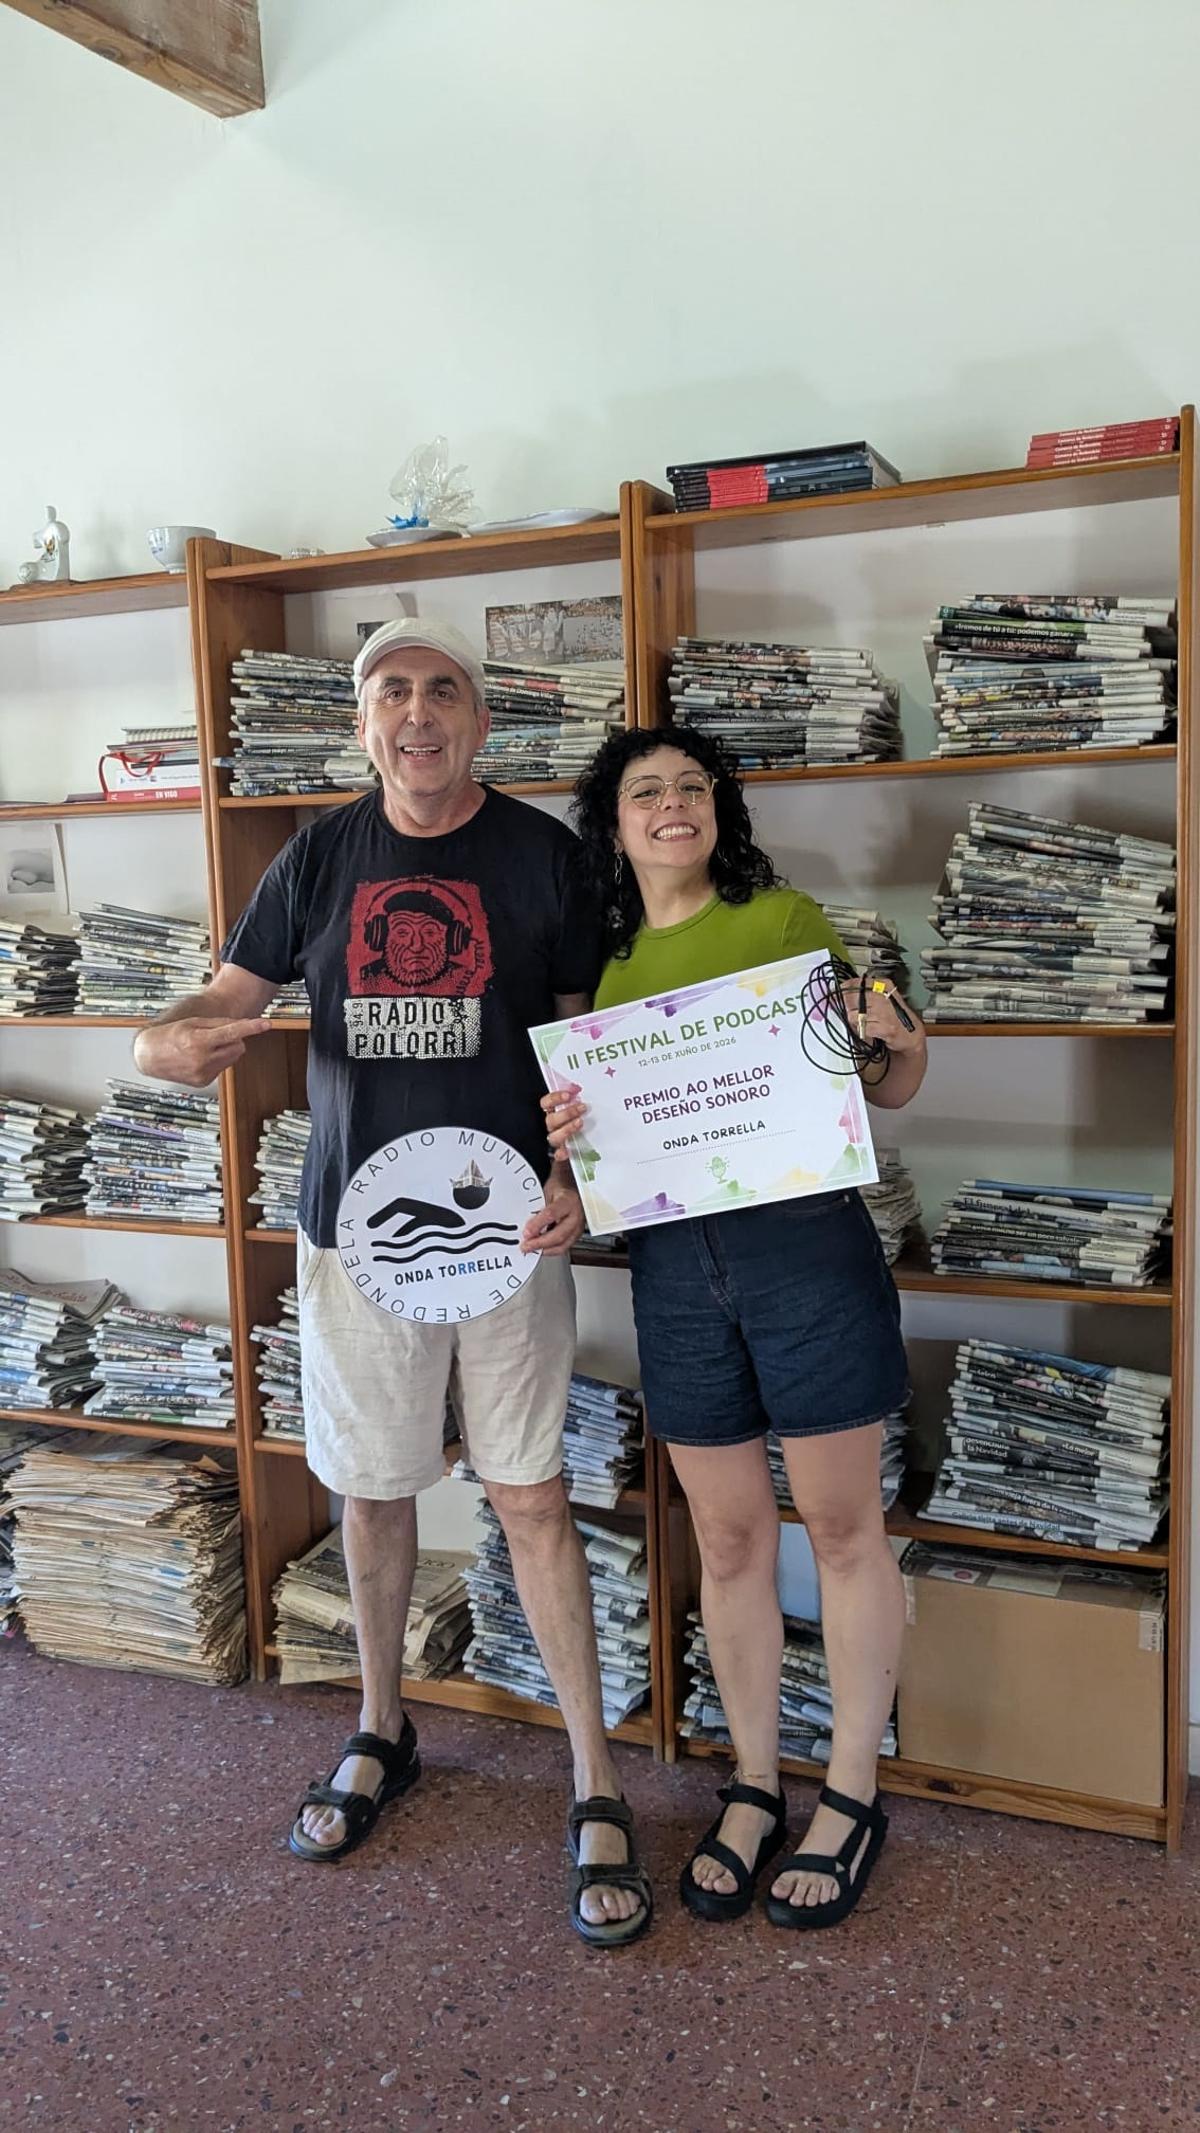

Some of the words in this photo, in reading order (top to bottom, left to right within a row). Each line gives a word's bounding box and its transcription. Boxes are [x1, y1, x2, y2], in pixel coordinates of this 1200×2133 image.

[1017, 627, 1049, 637] podemos
[368, 1001, 445, 1026] RADIO
[567, 1053, 580, 1070] II
[584, 1035, 675, 1065] FESTIVAL
[679, 1019, 708, 1041] DE
[661, 1053, 673, 1062] DE
[675, 1045, 698, 1059] XUÑO
[700, 1043, 712, 1053] DE
[714, 1037, 737, 1049] 2026
[623, 1086, 680, 1110] PREMIO
[686, 1080, 708, 1096] AO
[713, 1064, 775, 1089] MELLOR
[642, 1099, 701, 1124] DESEÑO
[705, 1084, 771, 1109] SONORO
[663, 1134, 699, 1150] ONDA
[702, 1120, 766, 1142] TORRELLA
[350, 1131, 435, 1194] RADIO
[340, 1218, 471, 1323] REDONDELA
[394, 1268, 434, 1285] ONDA
[438, 1256, 512, 1278] TORRELLA
[488, 1274, 522, 1305] DE
[975, 1445, 1008, 1458] Navidad
